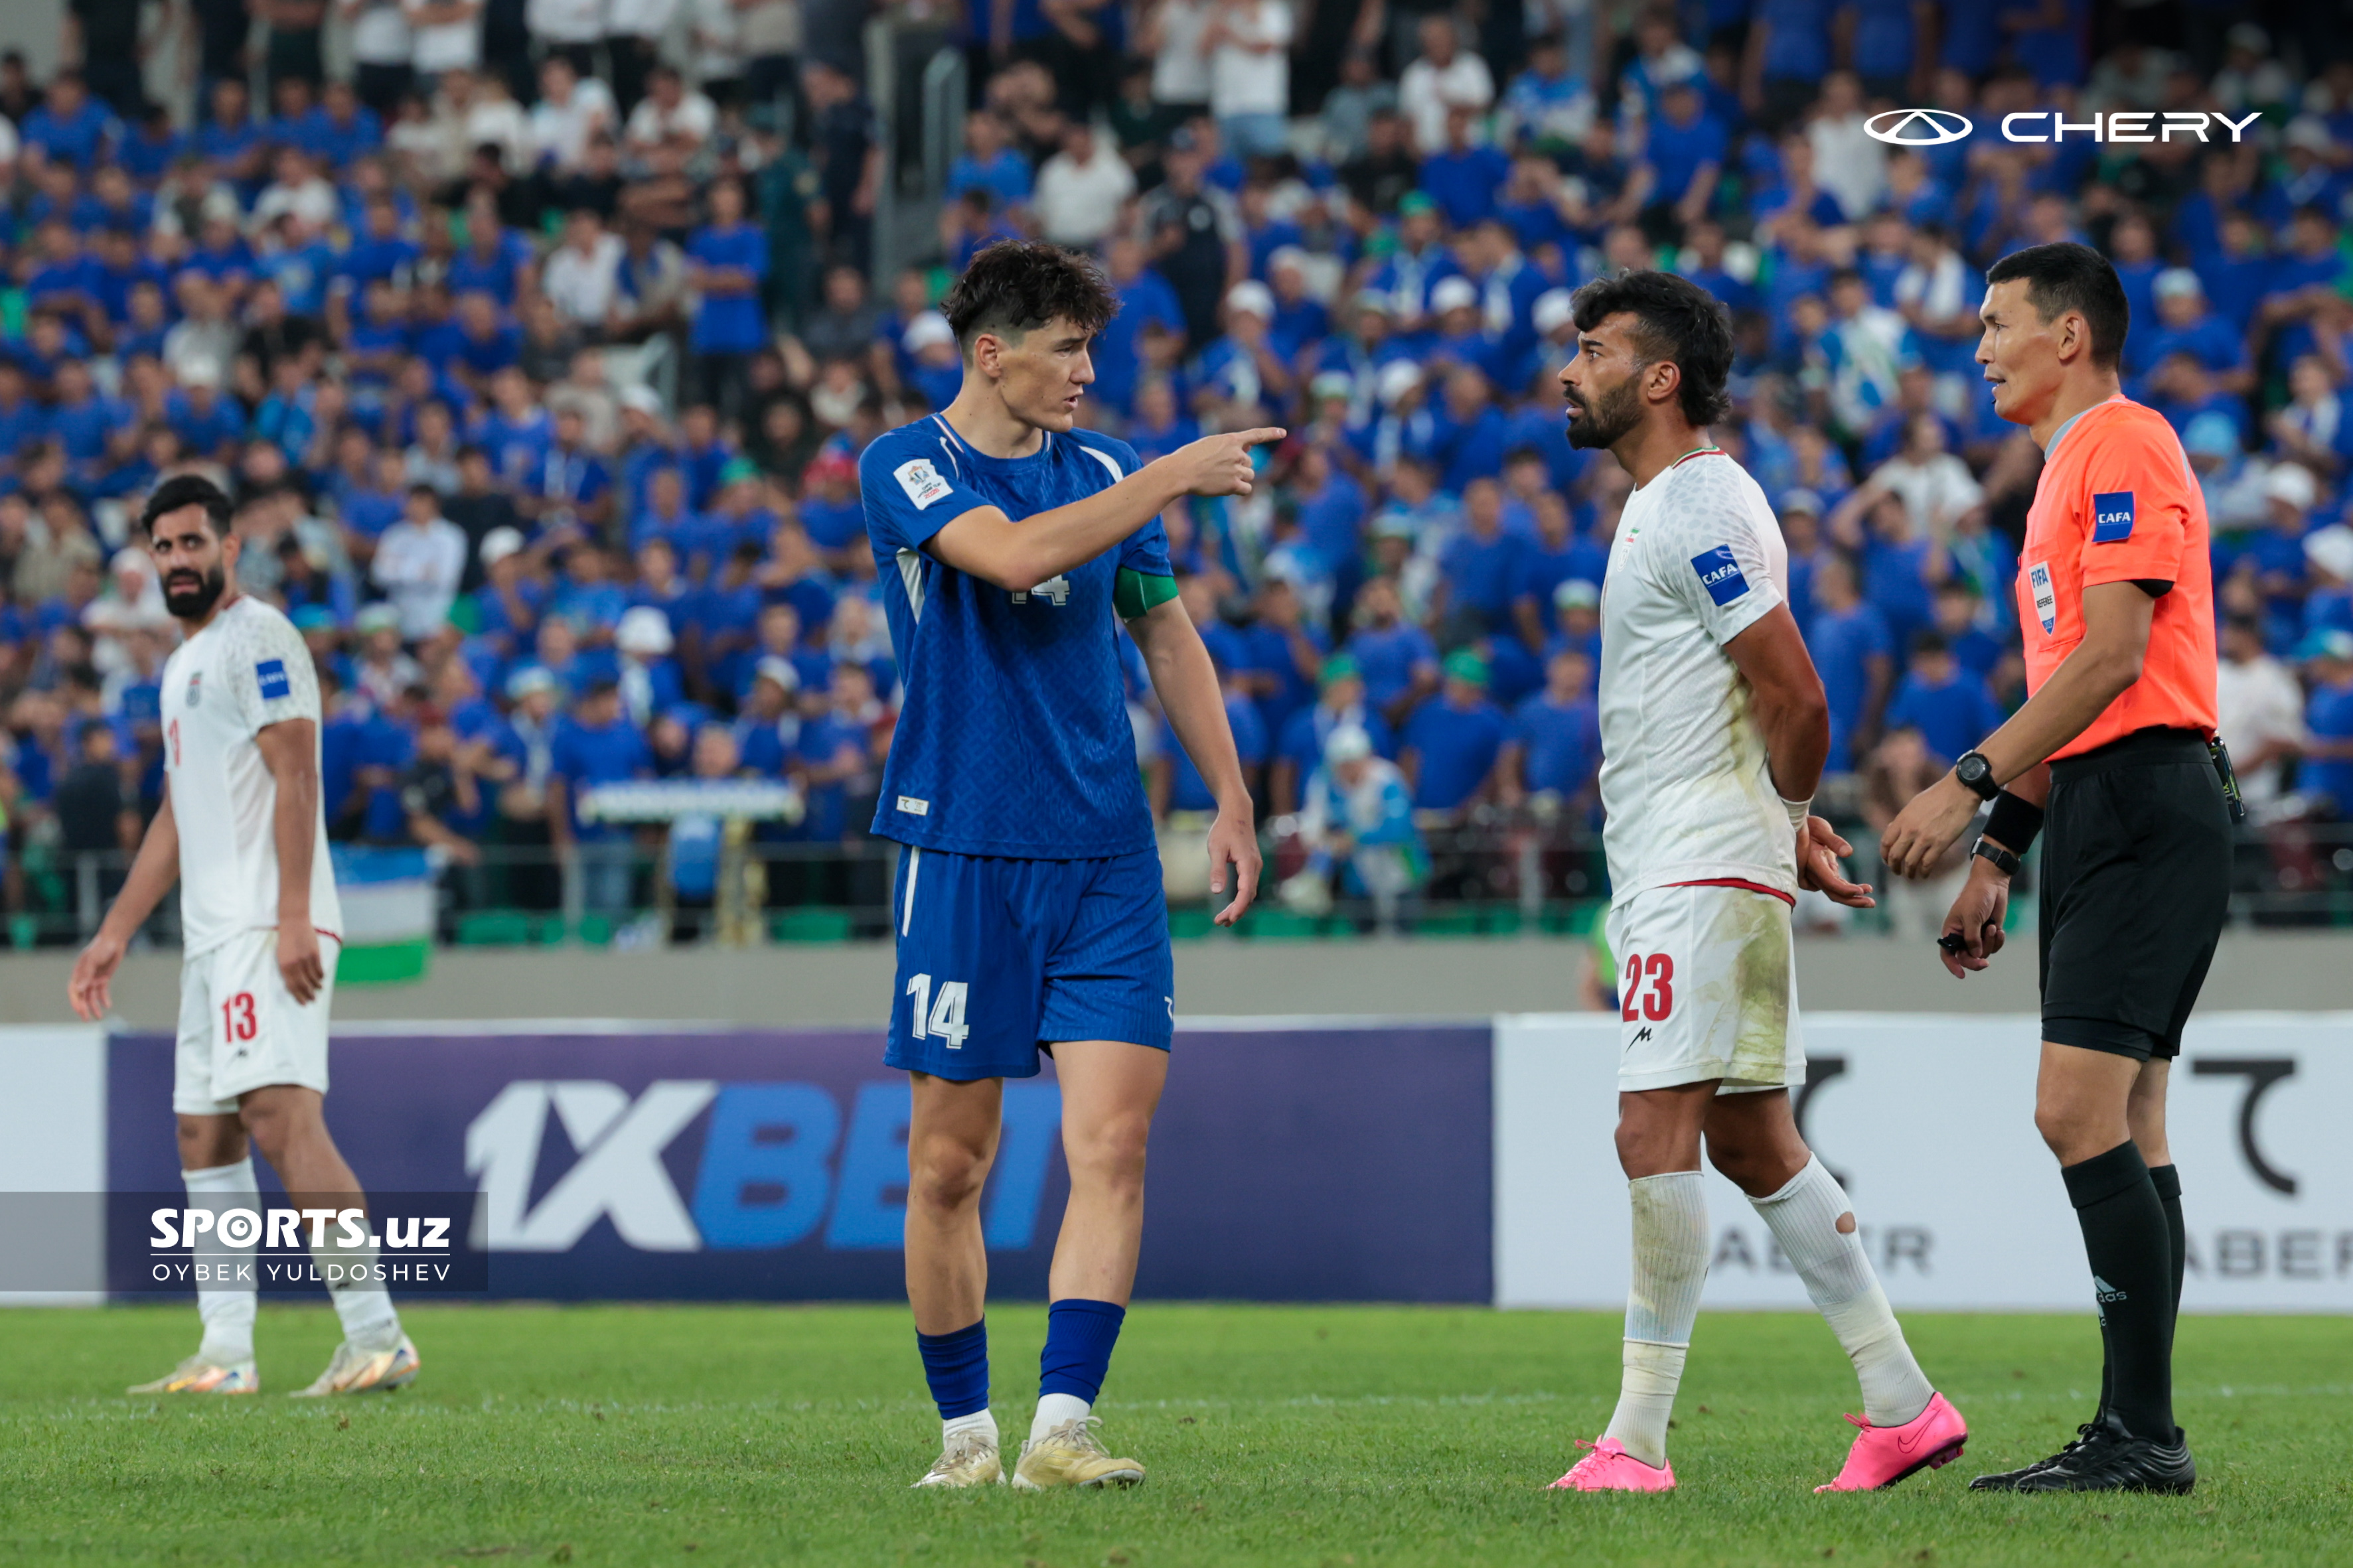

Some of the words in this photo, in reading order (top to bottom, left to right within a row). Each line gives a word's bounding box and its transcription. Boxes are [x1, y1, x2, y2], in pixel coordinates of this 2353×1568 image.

[2098, 512, 2131, 524] CAFA
[1702, 563, 1738, 585] CAFA
[2030, 567, 2048, 589] FIFA
[2036, 595, 2053, 608] REFEREE
[1622, 953, 1673, 1023] 23
[222, 992, 257, 1044] 13
[906, 973, 970, 1050] 14
[464, 1080, 1062, 1251] 1XBET
